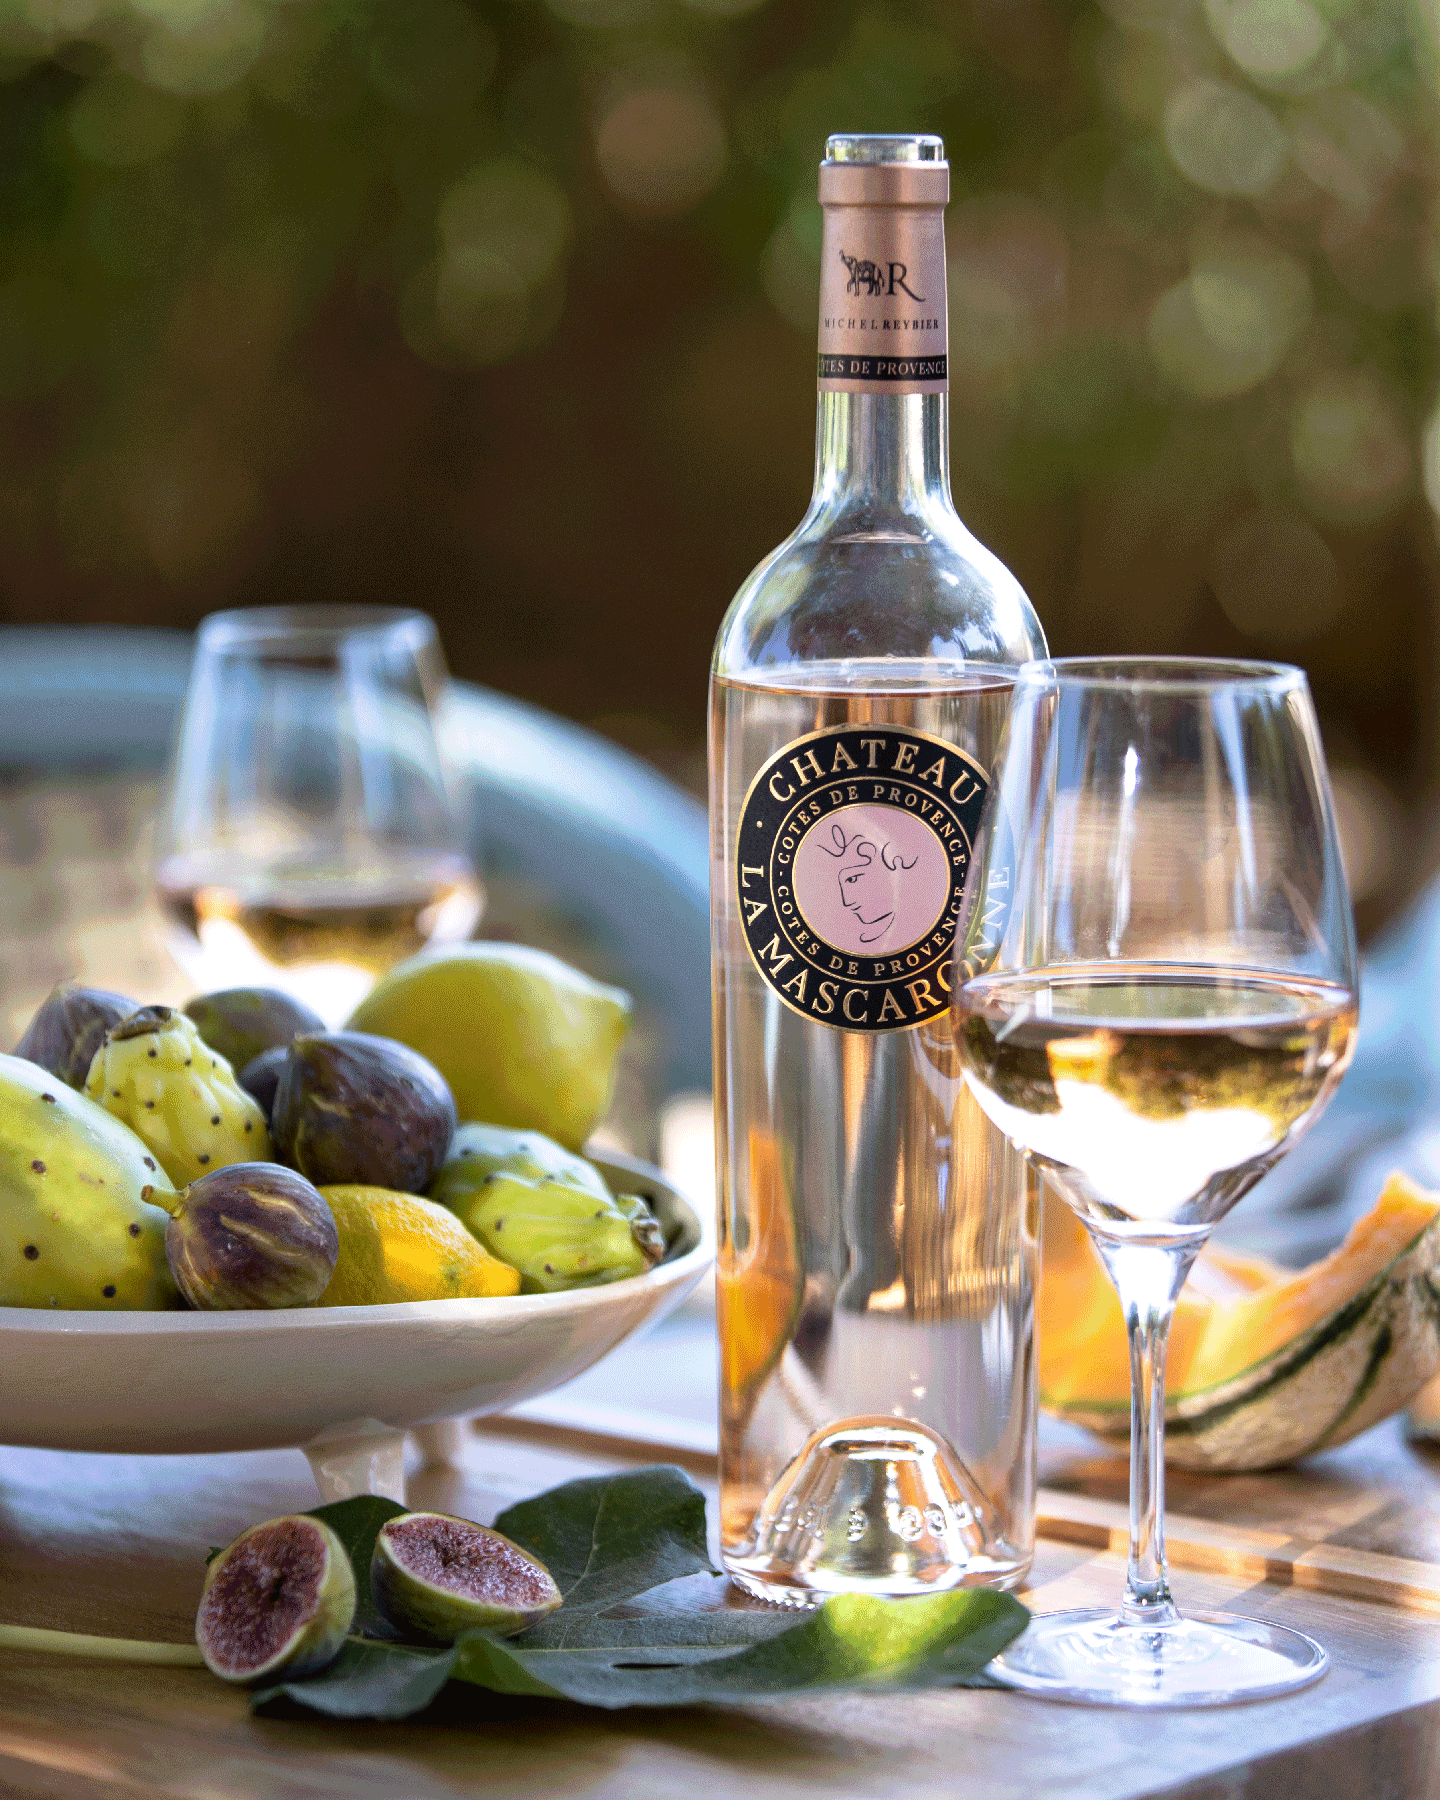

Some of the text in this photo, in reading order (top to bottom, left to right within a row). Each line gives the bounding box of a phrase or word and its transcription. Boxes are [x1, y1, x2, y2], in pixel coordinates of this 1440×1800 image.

[824, 318, 939, 331] MICHEL REYBIER
[850, 360, 871, 374] DE
[876, 360, 946, 376] PROVENCE
[768, 739, 982, 805] CHATEAU
[777, 784, 967, 867] COTES DE PROVENCE
[741, 863, 769, 927] LA
[777, 885, 966, 977] COTES DE PROVENCE
